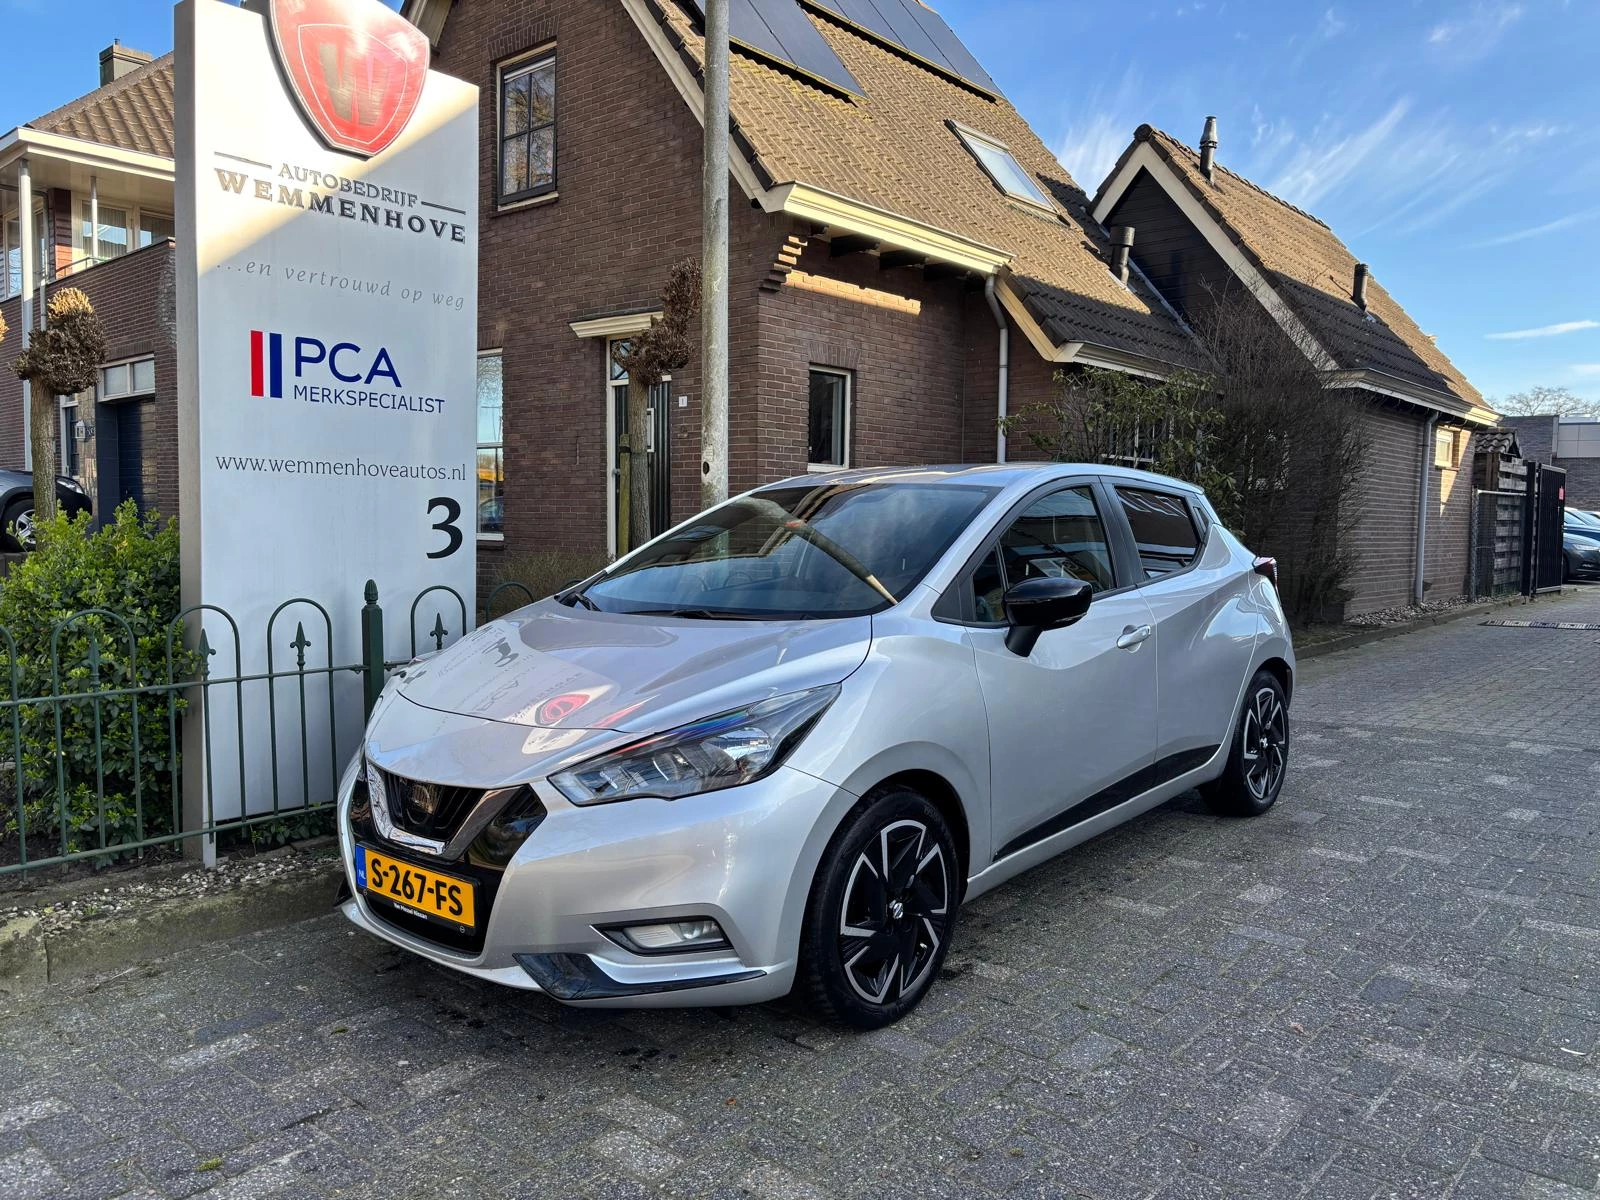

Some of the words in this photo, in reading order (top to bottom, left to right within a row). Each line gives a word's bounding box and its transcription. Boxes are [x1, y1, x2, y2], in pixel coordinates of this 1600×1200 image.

[213, 167, 466, 244] WEMMENHOVE
[278, 163, 418, 208] AUTOBEDRIJF
[285, 267, 391, 297] vertrouwd
[400, 286, 423, 303] op
[432, 293, 465, 311] weg
[294, 336, 402, 388] PCA
[294, 384, 445, 414] MERKSPECIALIST
[215, 456, 466, 481] www.wemmenhoveautos.nl
[426, 496, 463, 559] 3
[370, 858, 463, 917] S-267-FS
